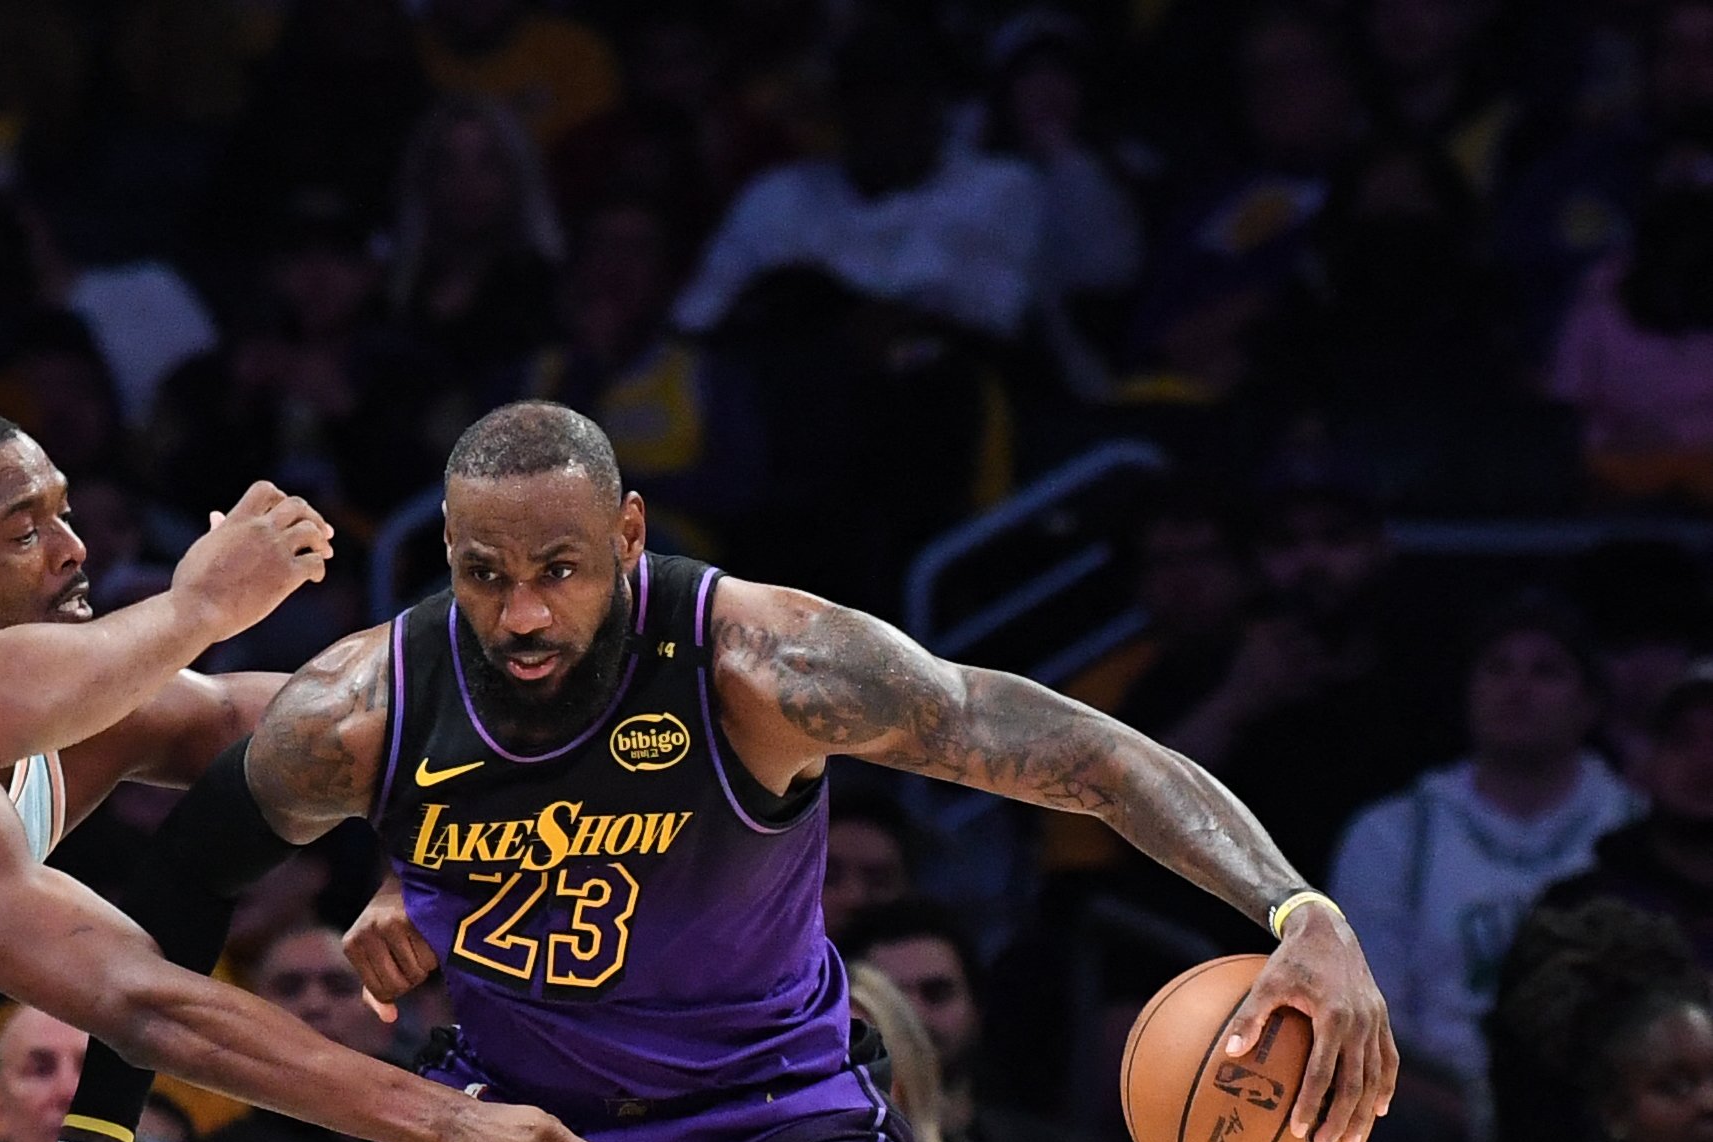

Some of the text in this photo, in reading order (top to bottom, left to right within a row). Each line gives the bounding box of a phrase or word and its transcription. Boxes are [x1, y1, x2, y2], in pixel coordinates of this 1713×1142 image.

[617, 728, 685, 753] bibigo
[630, 748, 660, 760] 비비고
[452, 862, 640, 988] 23
